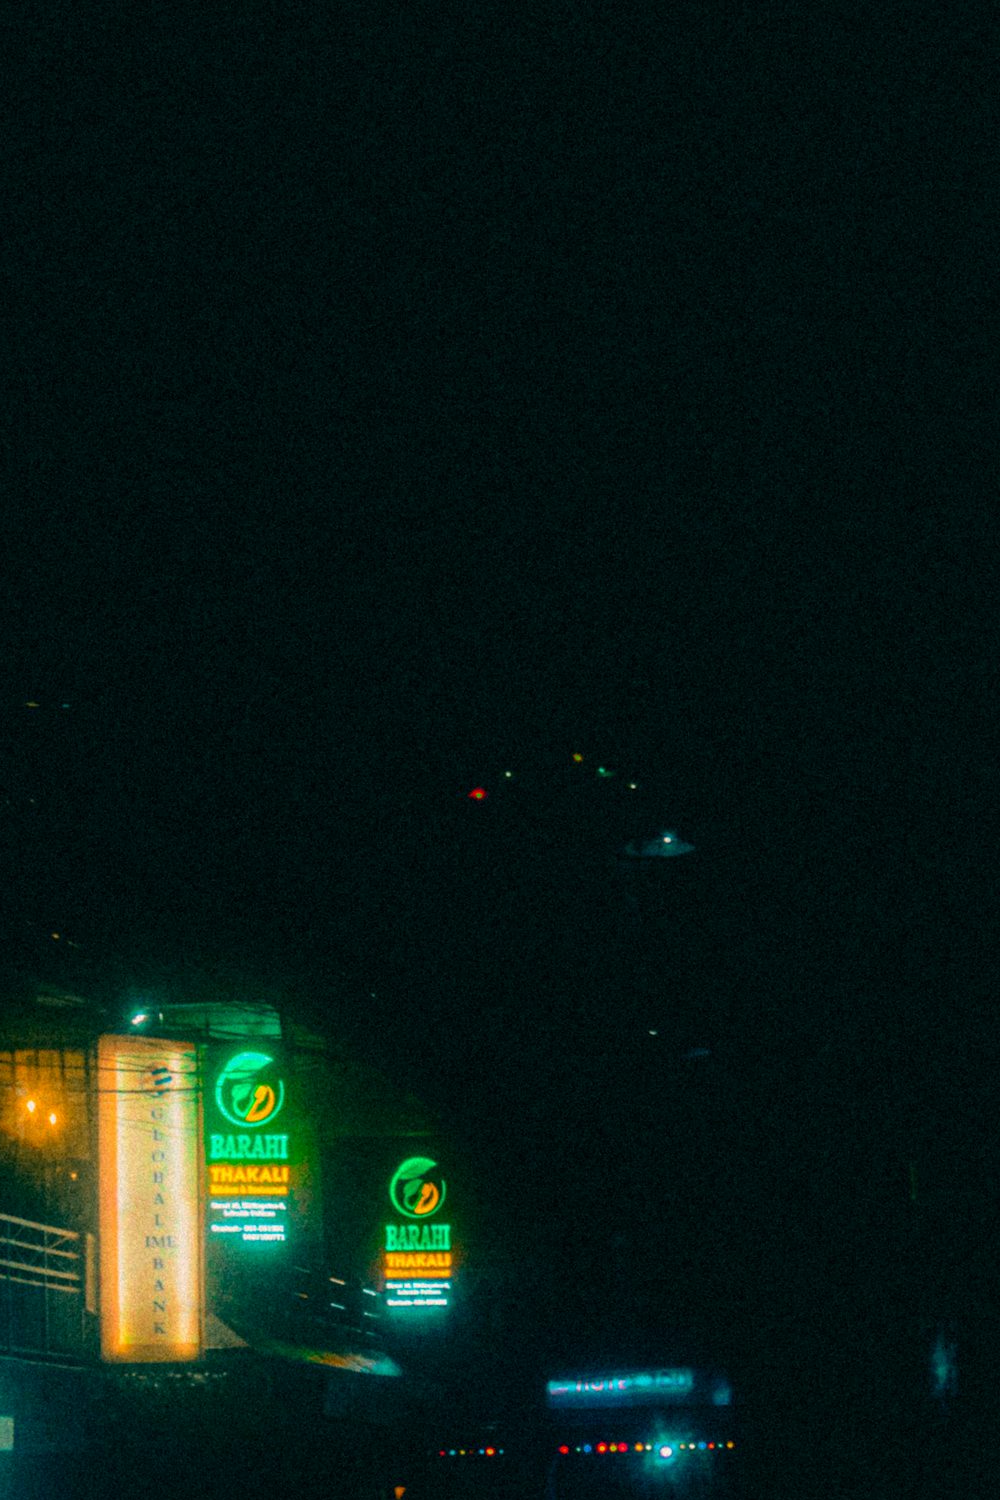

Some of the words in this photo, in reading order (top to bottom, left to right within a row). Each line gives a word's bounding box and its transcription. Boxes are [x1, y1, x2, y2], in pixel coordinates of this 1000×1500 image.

[210, 1134, 288, 1159] BARAHI
[150, 1107, 166, 1228] GLOBAL
[209, 1165, 290, 1183] THAKALI
[144, 1235, 177, 1249] IME
[385, 1224, 452, 1251] BARAHI
[385, 1252, 452, 1267] THAKALI
[153, 1257, 167, 1335] BANK
